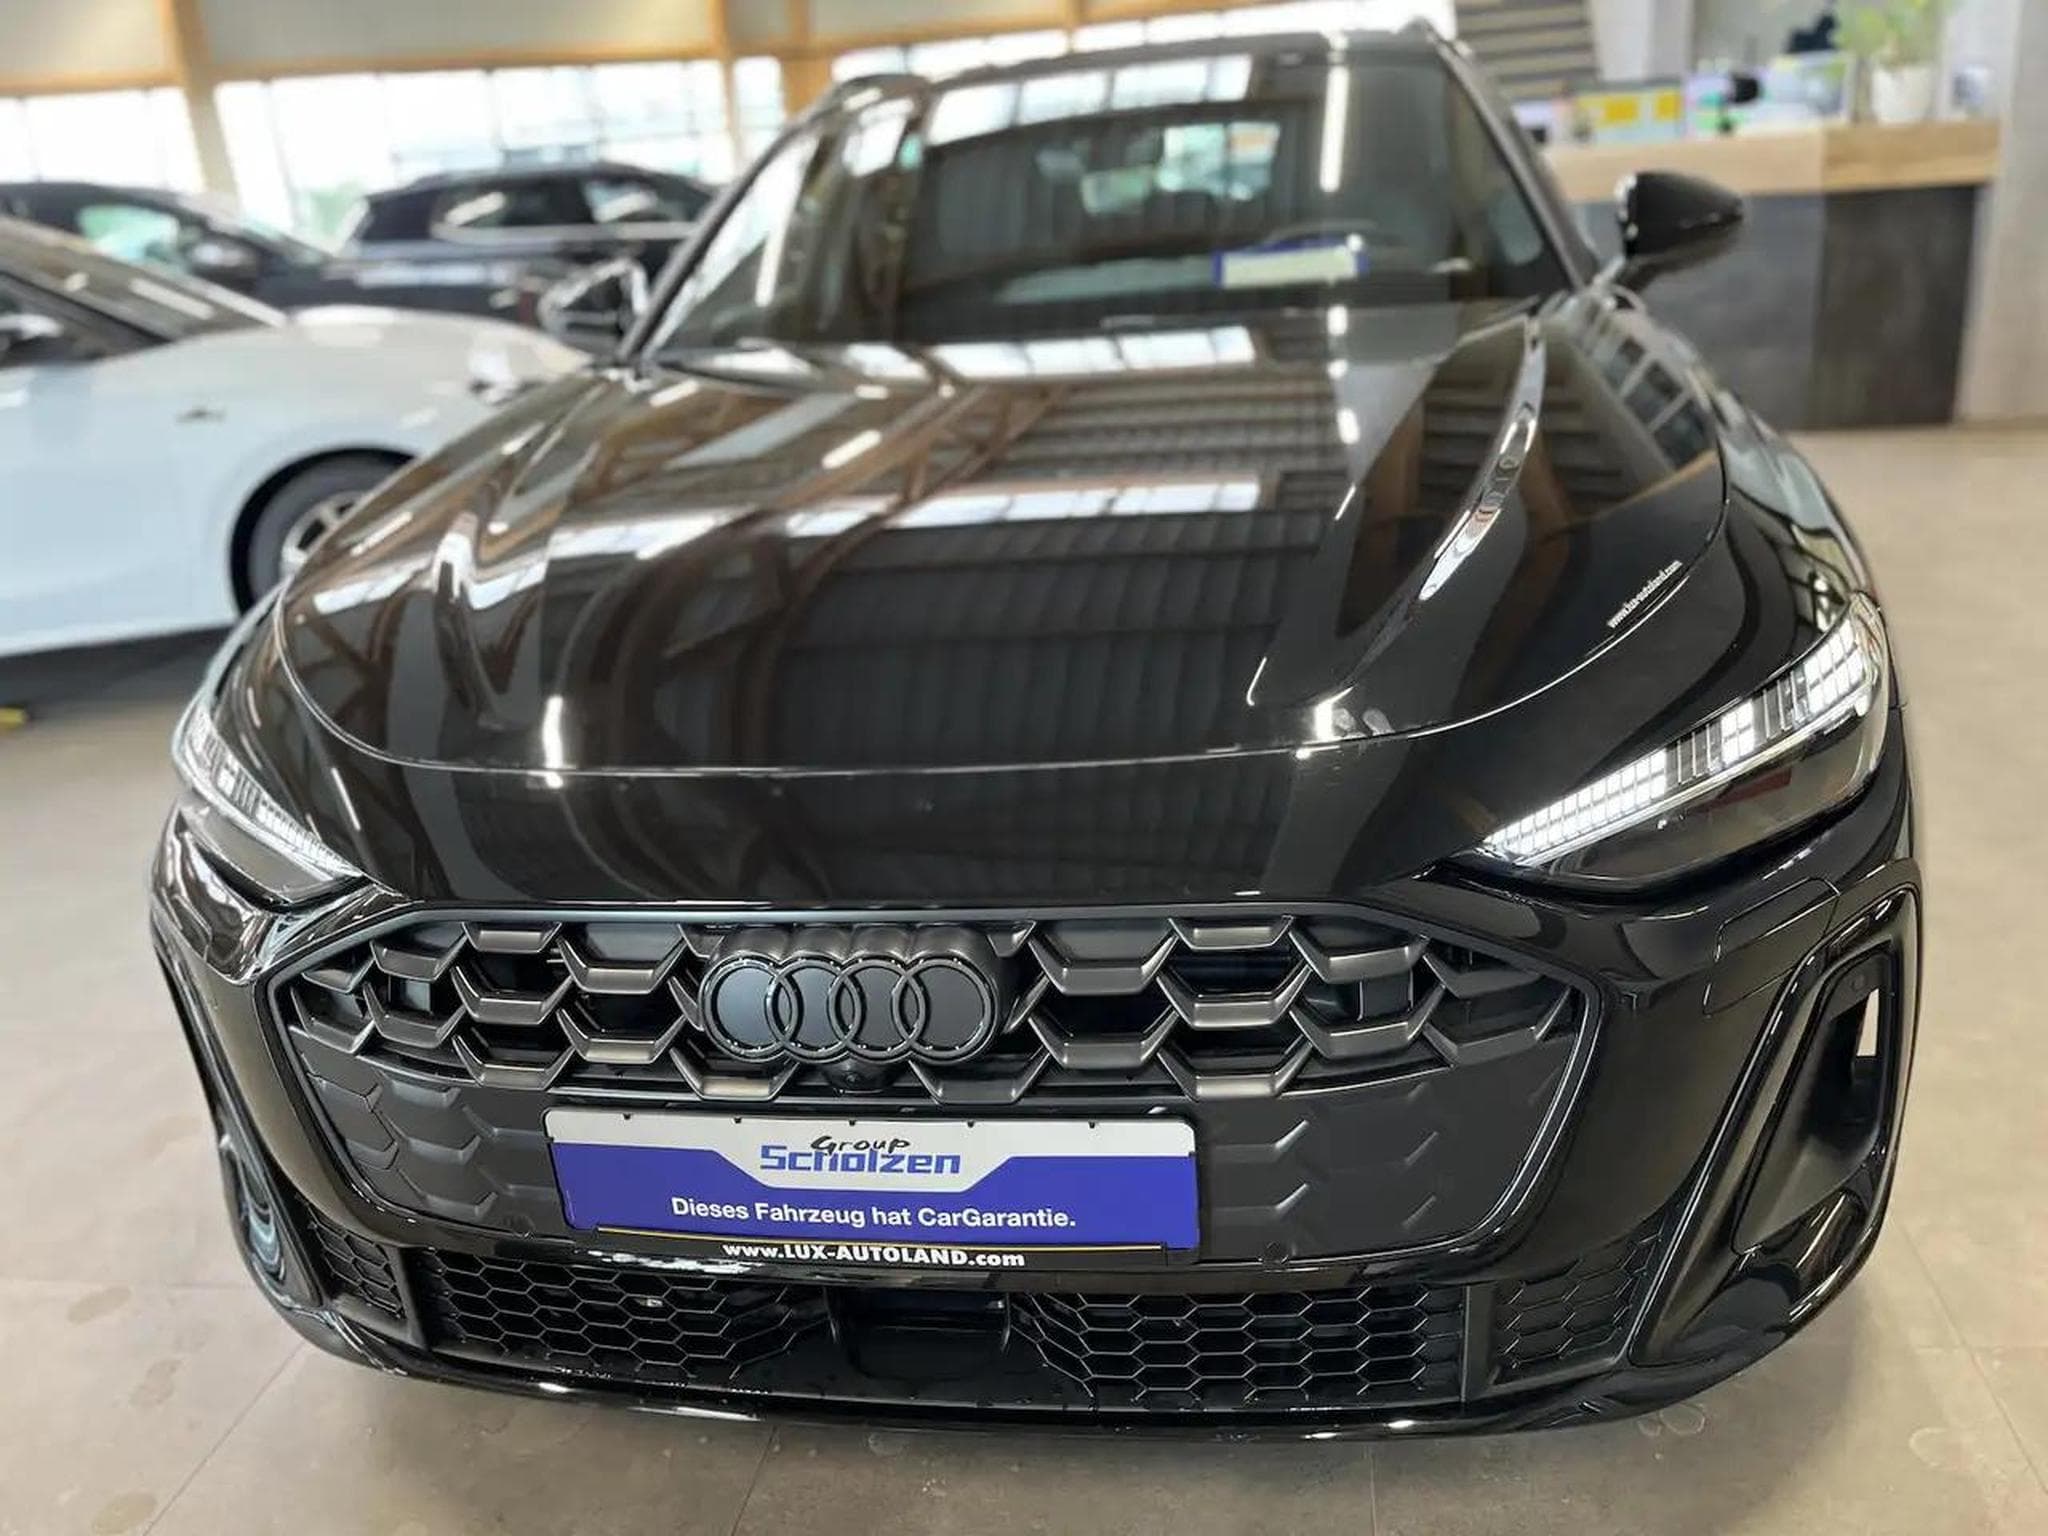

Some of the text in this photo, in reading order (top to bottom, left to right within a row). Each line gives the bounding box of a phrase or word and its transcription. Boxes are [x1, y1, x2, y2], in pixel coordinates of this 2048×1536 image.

[811, 1135, 911, 1154] Group
[760, 1145, 961, 1174] Scholzen
[671, 1197, 1077, 1229] Dieses Fahrzeug hat CarGarantie.
[723, 1243, 1025, 1267] www.LUX-AUTOLAND.com
